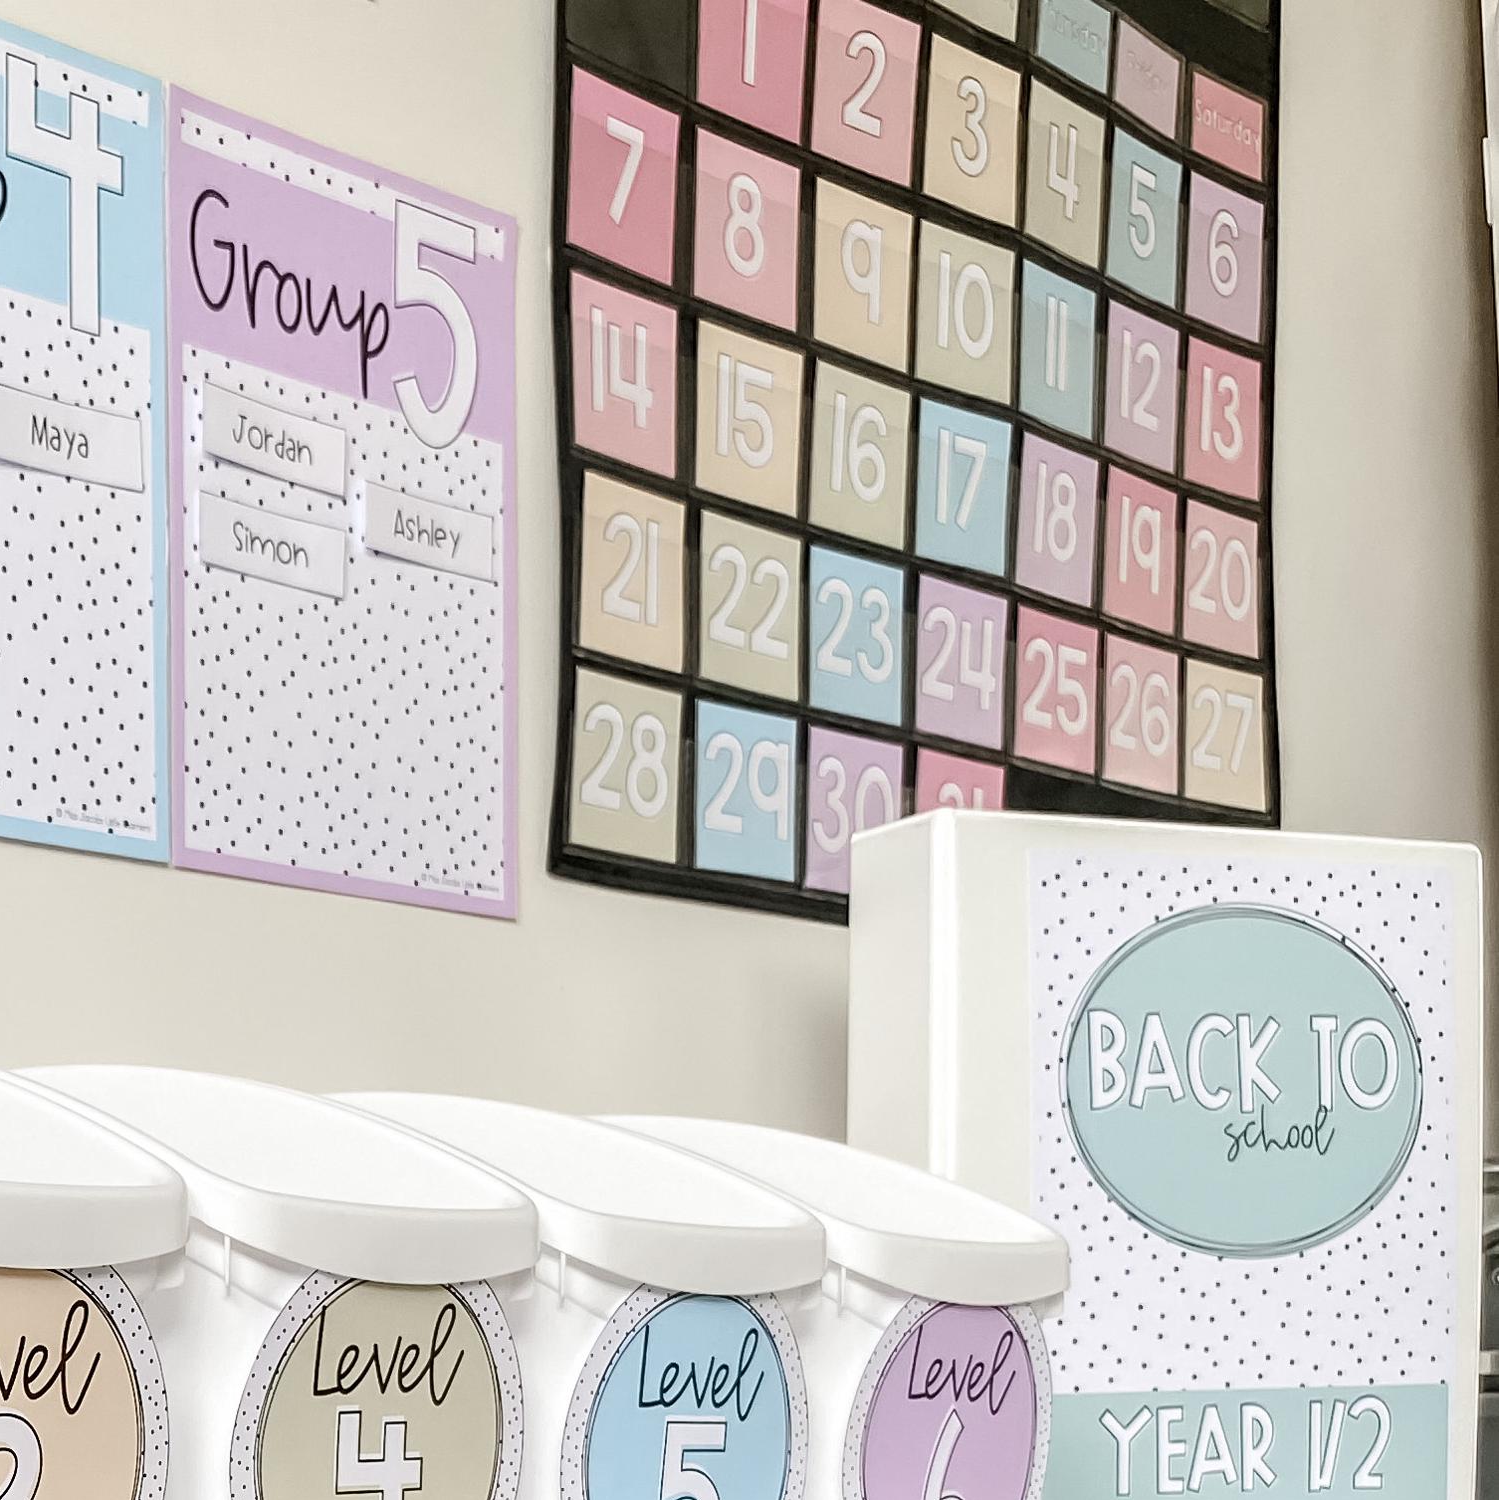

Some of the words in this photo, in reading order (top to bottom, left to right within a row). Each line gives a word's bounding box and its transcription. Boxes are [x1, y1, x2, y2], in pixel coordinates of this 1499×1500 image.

[6, 53, 124, 336] 4
[742, 0, 758, 87] 1
[842, 30, 887, 138] 2
[951, 76, 988, 177] 3
[1047, 122, 1079, 222] 4
[1129, 161, 1157, 259] 5
[1209, 209, 1238, 297] 6
[190, 189, 390, 399] Group
[393, 199, 478, 449] 5
[606, 114, 644, 225] 7
[723, 173, 764, 278] 8
[842, 219, 883, 325] 9
[936, 250, 994, 359] 10
[1046, 296, 1067, 392] 11
[1121, 329, 1161, 432] 12
[1201, 365, 1244, 460] 13
[31, 415, 90, 460] Maya
[232, 415, 312, 466] Jordan
[590, 305, 654, 429] 14
[716, 352, 774, 469] 15
[828, 392, 886, 500] 16
[937, 427, 987, 532] 17
[1033, 462, 1077, 563] 18
[1119, 496, 1161, 594] 19
[1188, 529, 1250, 621] 20
[232, 521, 309, 568] Simon
[394, 510, 461, 559] Ashley
[602, 513, 660, 627] 21
[708, 544, 790, 660] 22
[816, 577, 894, 684] 23
[922, 607, 996, 711] 24
[1023, 638, 1088, 736] 25
[1110, 664, 1170, 757] 26
[1192, 687, 1253, 775] 27
[581, 703, 668, 818] 28
[704, 732, 790, 841] 29
[812, 757, 894, 853] 30
[1087, 1009, 1282, 1114] BACK
[1310, 1015, 1399, 1111] TO
[1223, 1103, 1334, 1161] school
[313, 1303, 464, 1406] Level
[639, 1323, 764, 1422] Level
[908, 1323, 1016, 1415] Level
[1099, 1404, 1278, 1496] YEAR
[1308, 1395, 1392, 1493] 1/2
